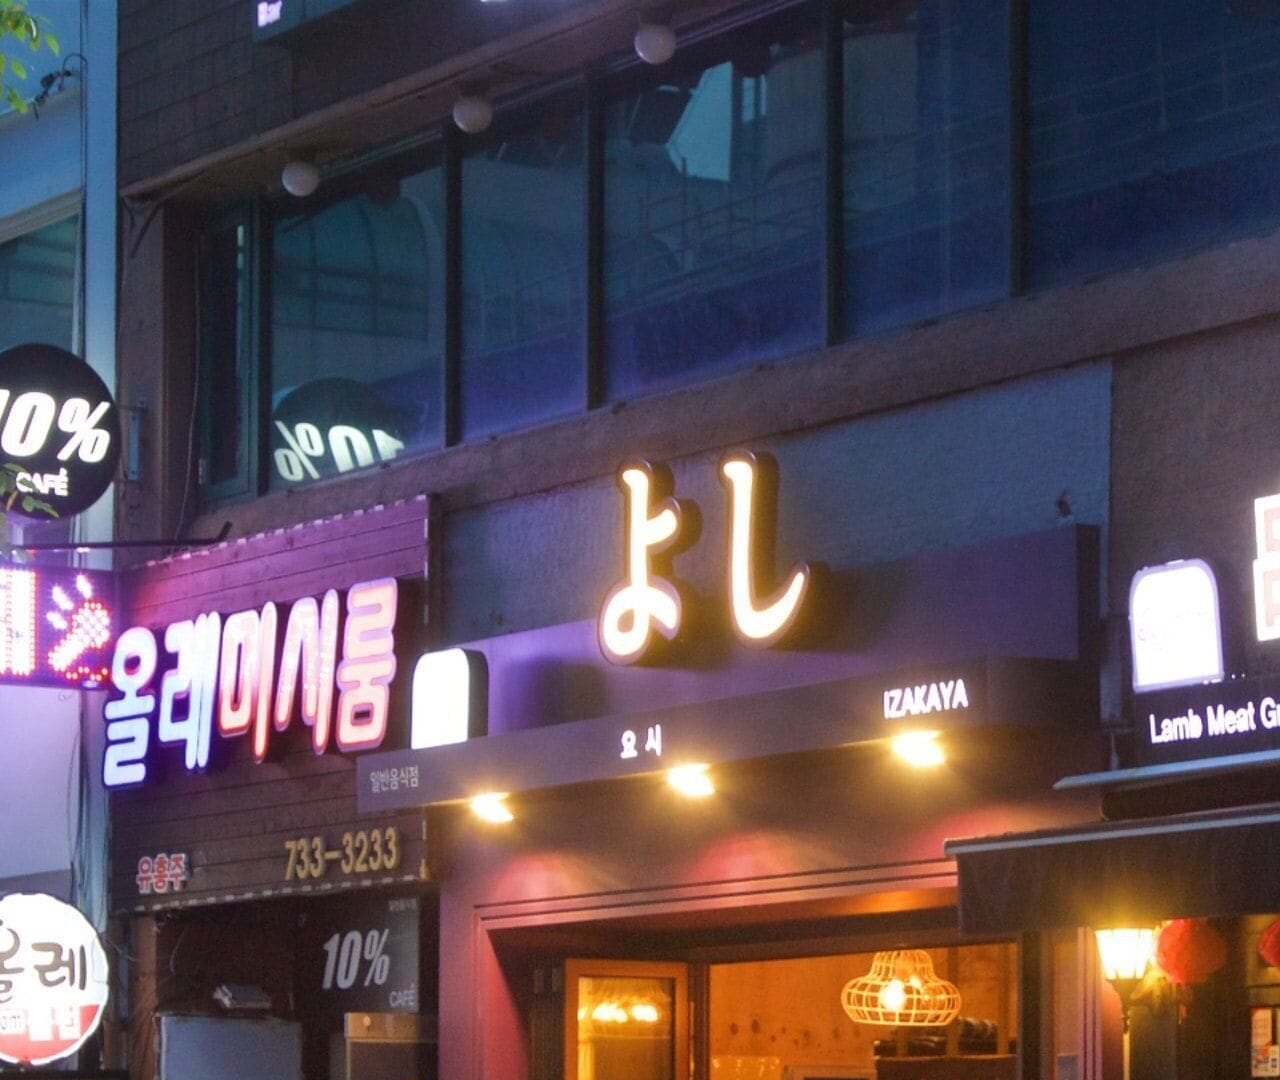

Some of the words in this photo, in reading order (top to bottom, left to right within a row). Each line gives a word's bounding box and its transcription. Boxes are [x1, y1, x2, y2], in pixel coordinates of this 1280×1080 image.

[600, 459, 808, 658] よし
[102, 576, 399, 788] 올레미시룸
[882, 678, 970, 720] IZAKAYA
[1149, 709, 1204, 744] Lamb
[1207, 703, 1257, 736] Meat
[369, 765, 420, 794] 일반음식점
[135, 853, 187, 894] 유흥주
[284, 826, 399, 881] 733-3233
[322, 928, 391, 991] 10%
